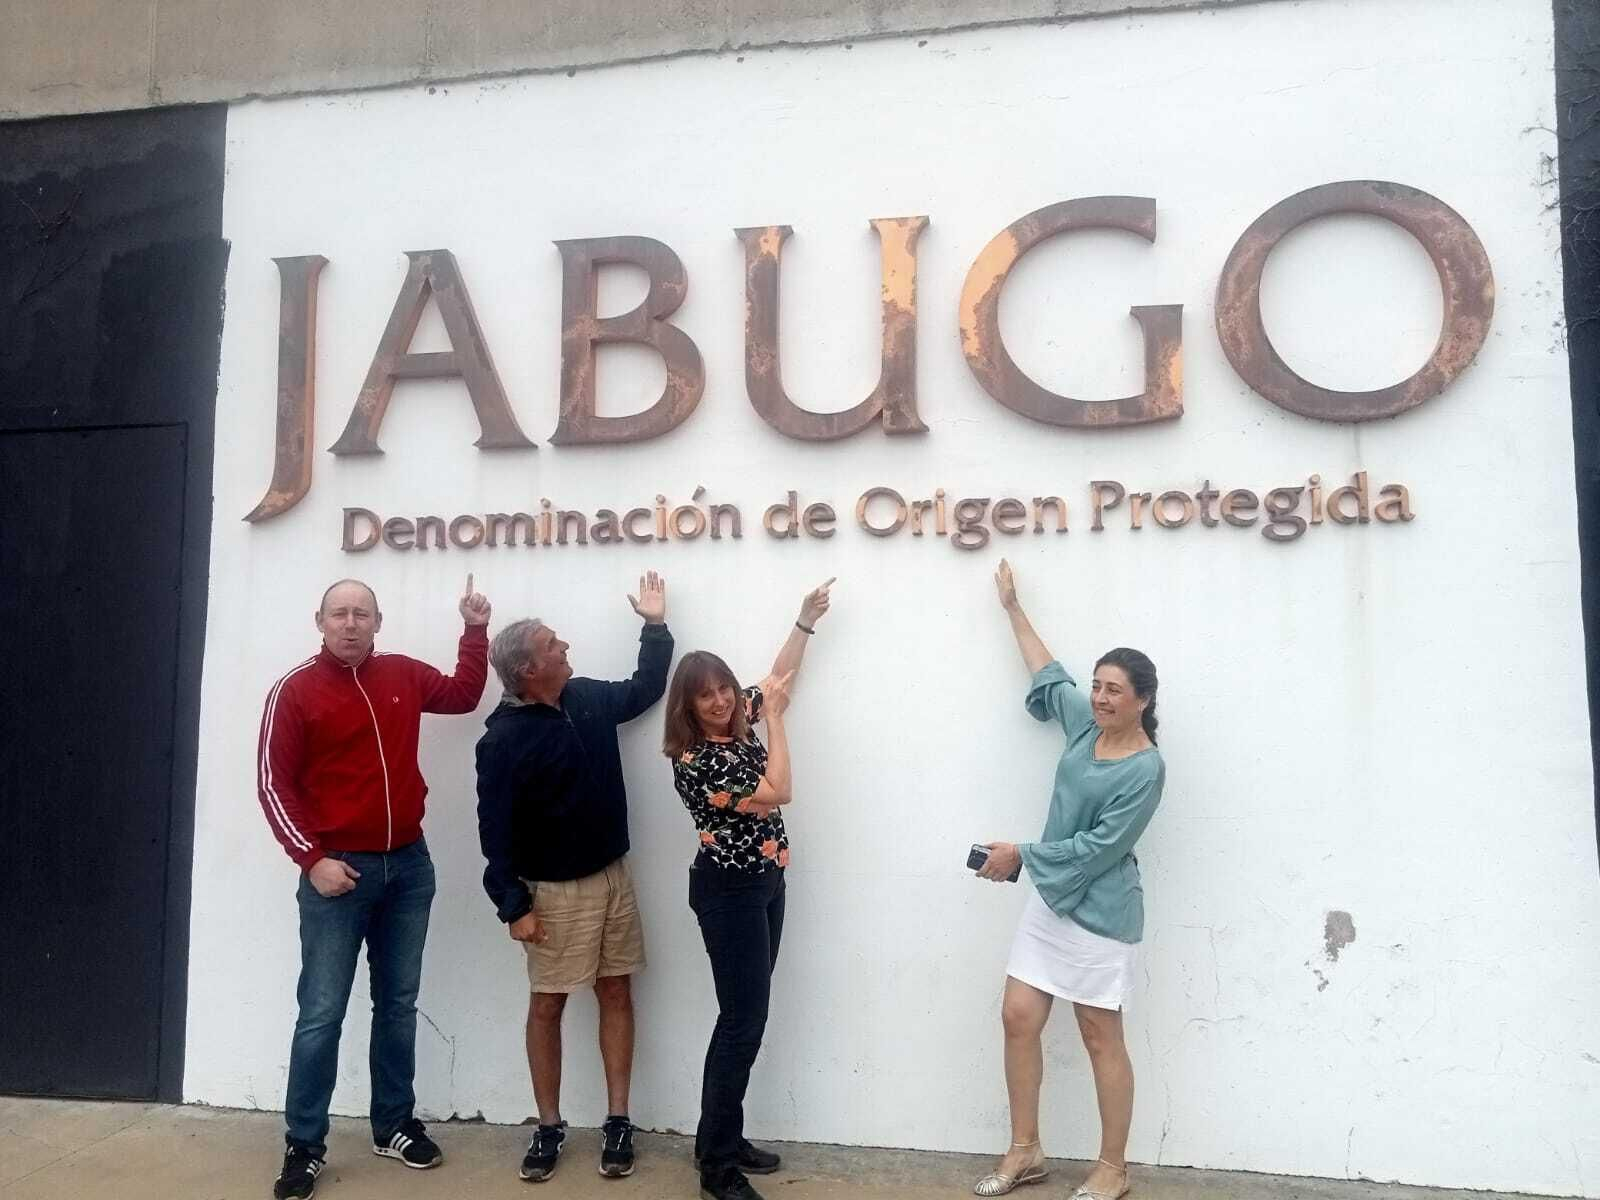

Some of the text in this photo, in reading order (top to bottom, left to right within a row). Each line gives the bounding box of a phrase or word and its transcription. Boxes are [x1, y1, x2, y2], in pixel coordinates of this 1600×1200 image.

[242, 180, 1495, 525] JABUGO
[342, 471, 1416, 553] Denominación de Origen Protegida
